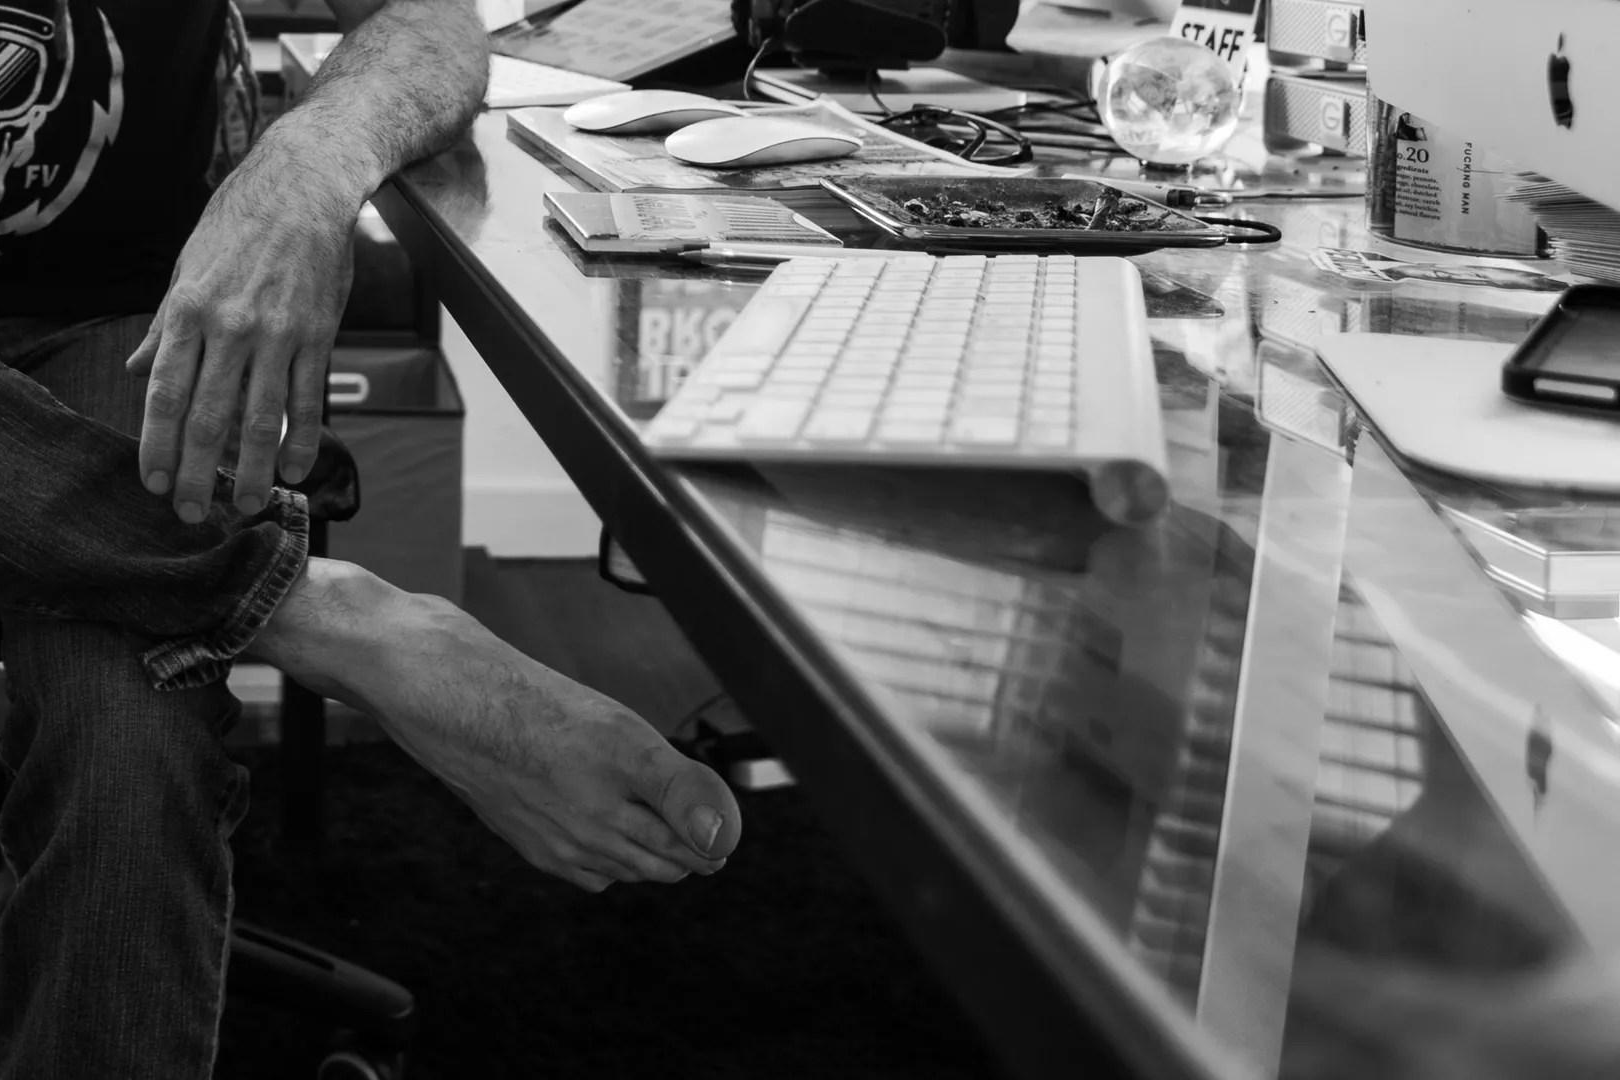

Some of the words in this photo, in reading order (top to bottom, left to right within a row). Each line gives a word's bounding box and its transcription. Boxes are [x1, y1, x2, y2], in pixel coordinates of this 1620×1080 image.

[1181, 22, 1245, 62] STAFF
[25, 164, 60, 188] FV
[1462, 142, 1473, 189] FUCKING
[1461, 192, 1470, 215] MAN
